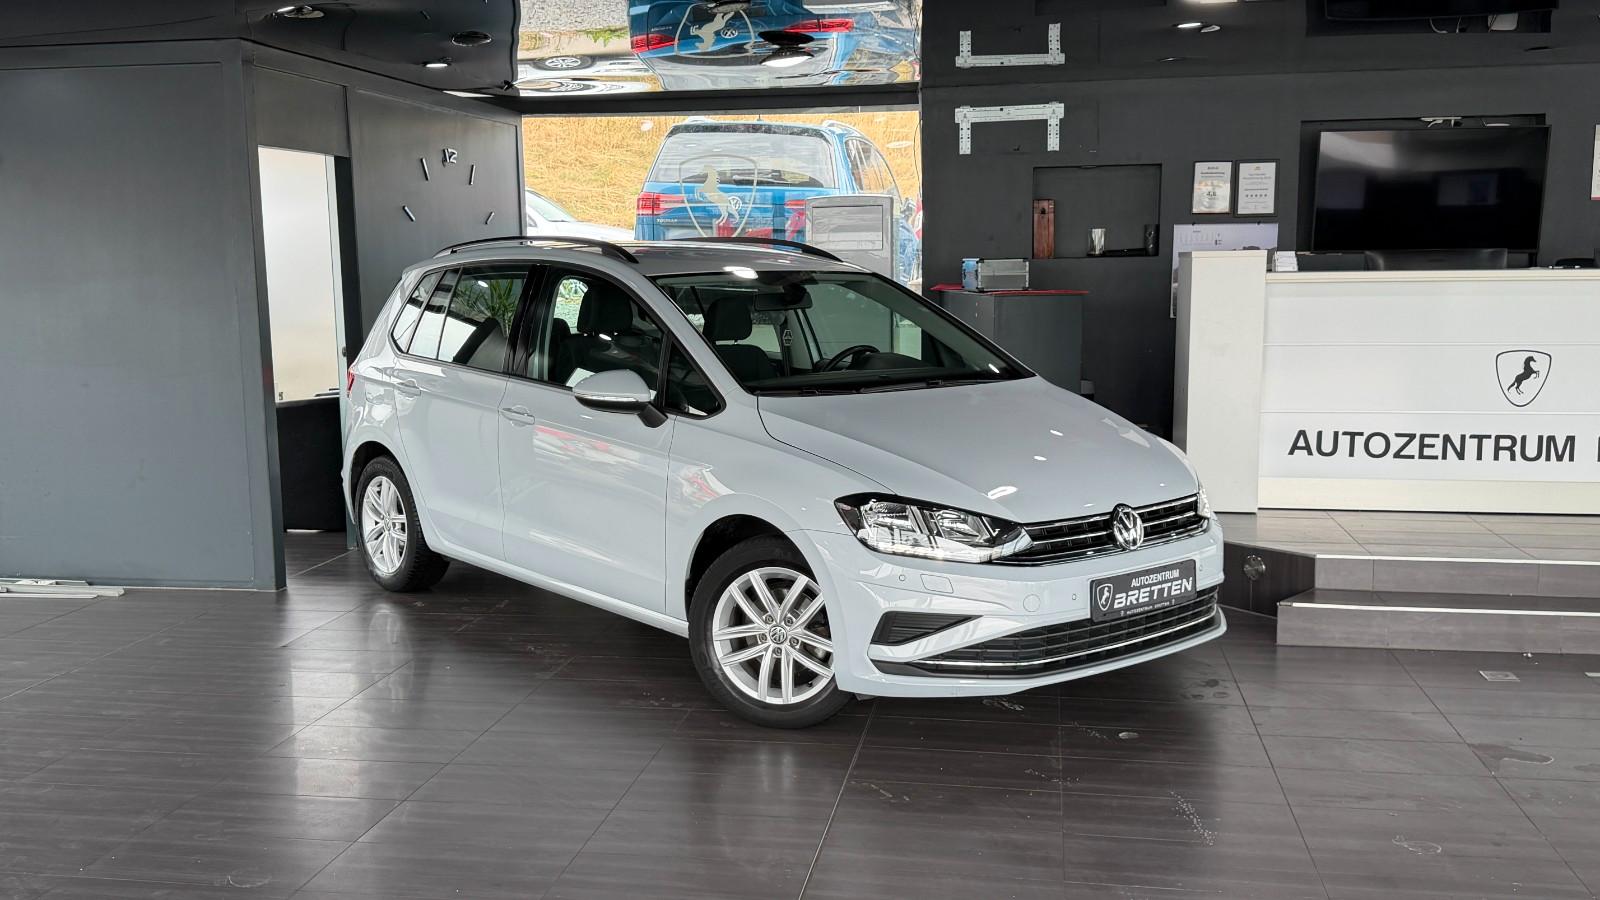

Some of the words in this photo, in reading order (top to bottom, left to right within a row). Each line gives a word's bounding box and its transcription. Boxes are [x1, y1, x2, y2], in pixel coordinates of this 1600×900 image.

[443, 148, 458, 163] 12
[1288, 429, 1576, 463] AUTOZENTRUM
[1131, 569, 1179, 588] AUTOZENTRUM
[1113, 577, 1193, 609] BRETTEN
